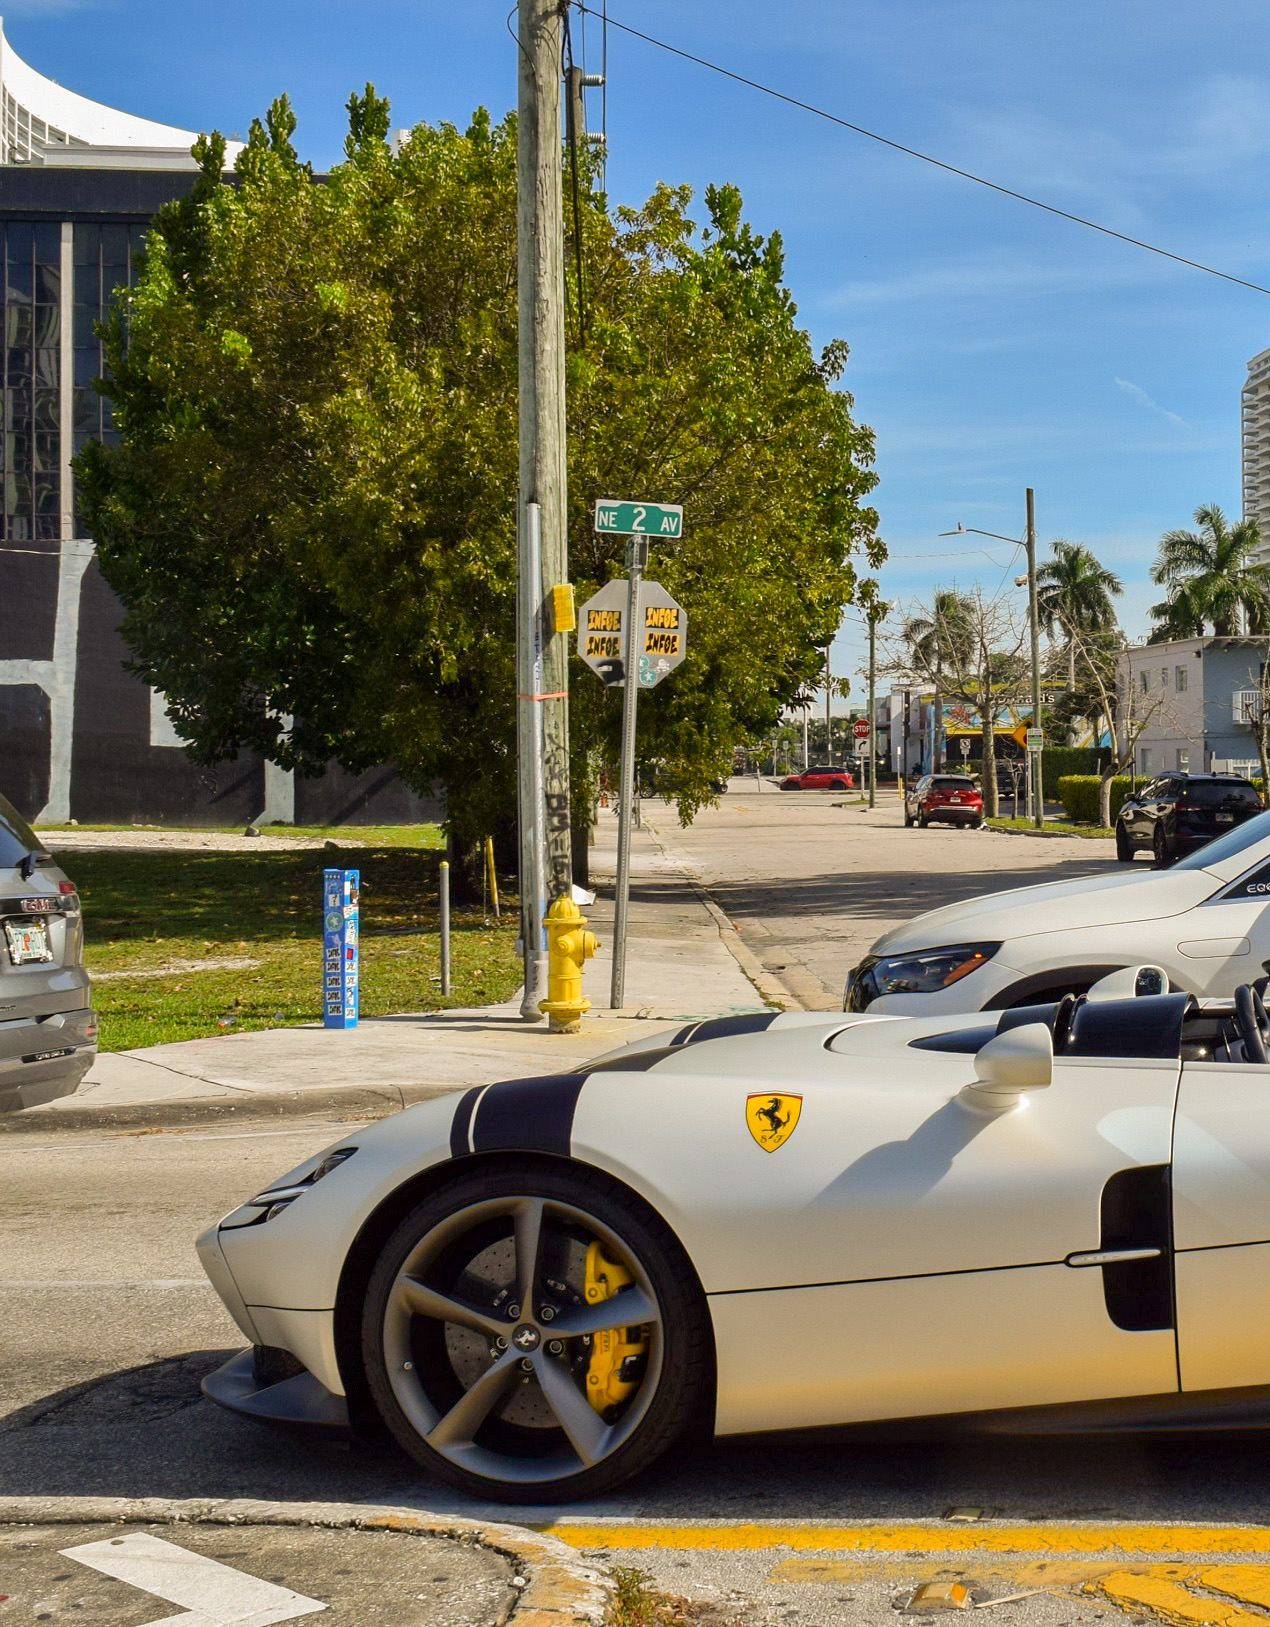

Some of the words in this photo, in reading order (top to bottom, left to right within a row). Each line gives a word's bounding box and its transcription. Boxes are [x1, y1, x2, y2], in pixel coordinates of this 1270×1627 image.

[599, 511, 618, 528] NE
[632, 506, 647, 531] 2
[660, 516, 679, 532] AV
[854, 725, 870, 733] STOP
[21, 898, 57, 912] GMC
